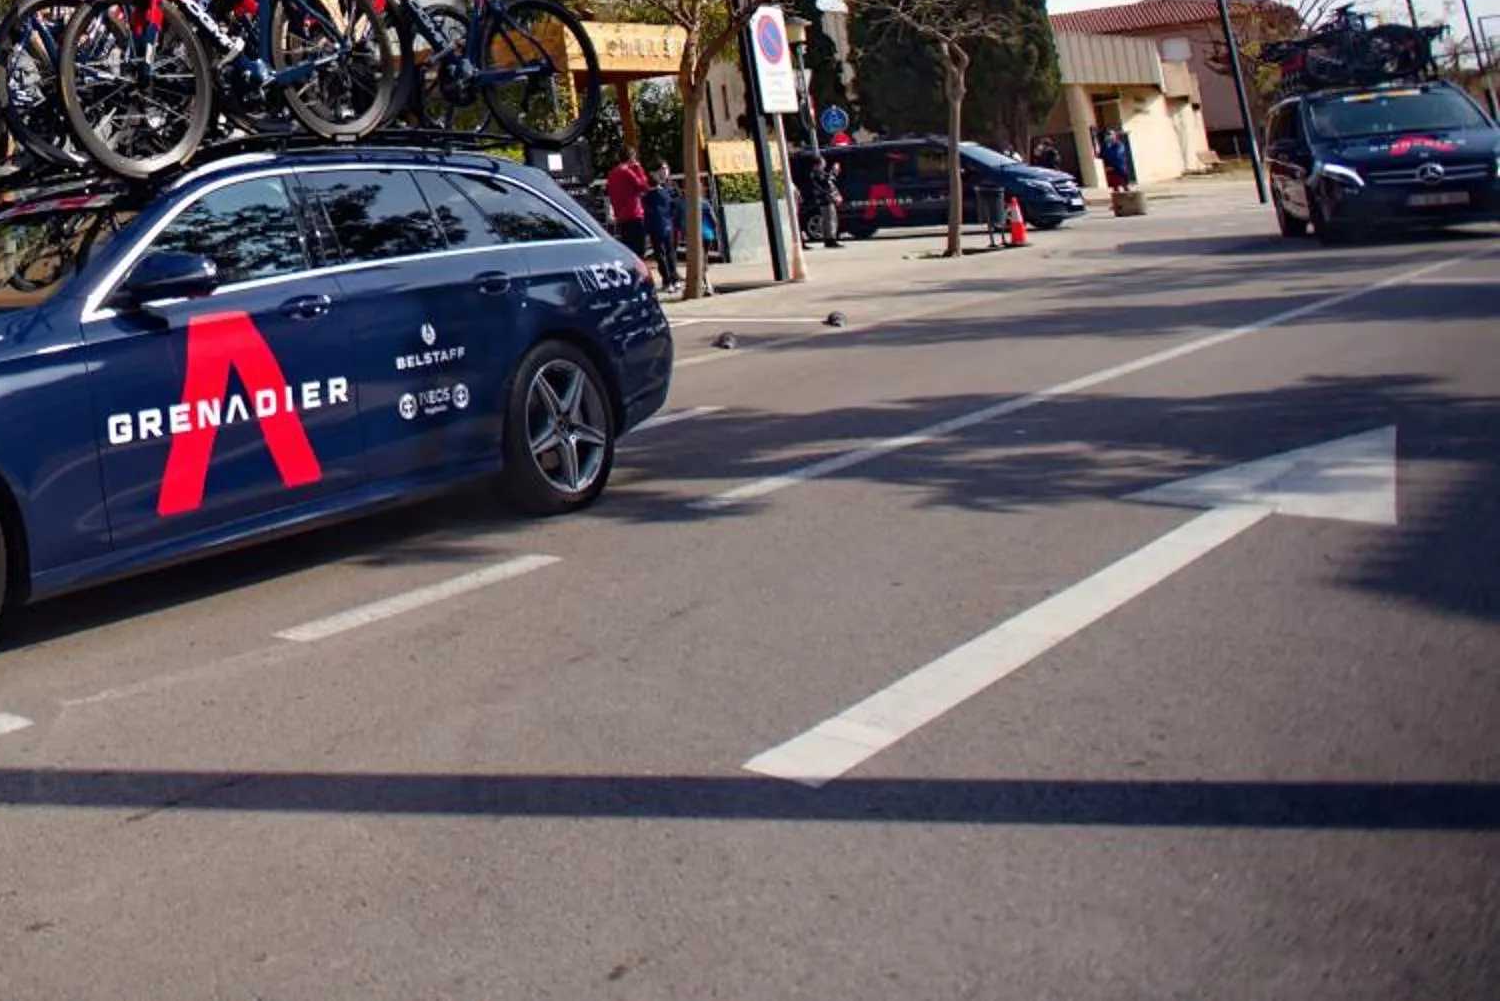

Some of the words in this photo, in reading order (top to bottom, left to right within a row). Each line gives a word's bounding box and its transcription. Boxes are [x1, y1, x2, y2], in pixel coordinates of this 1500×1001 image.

[572, 260, 632, 293] INEOS
[395, 345, 466, 370] BELSTAFF
[107, 375, 350, 445] GRENADIER
